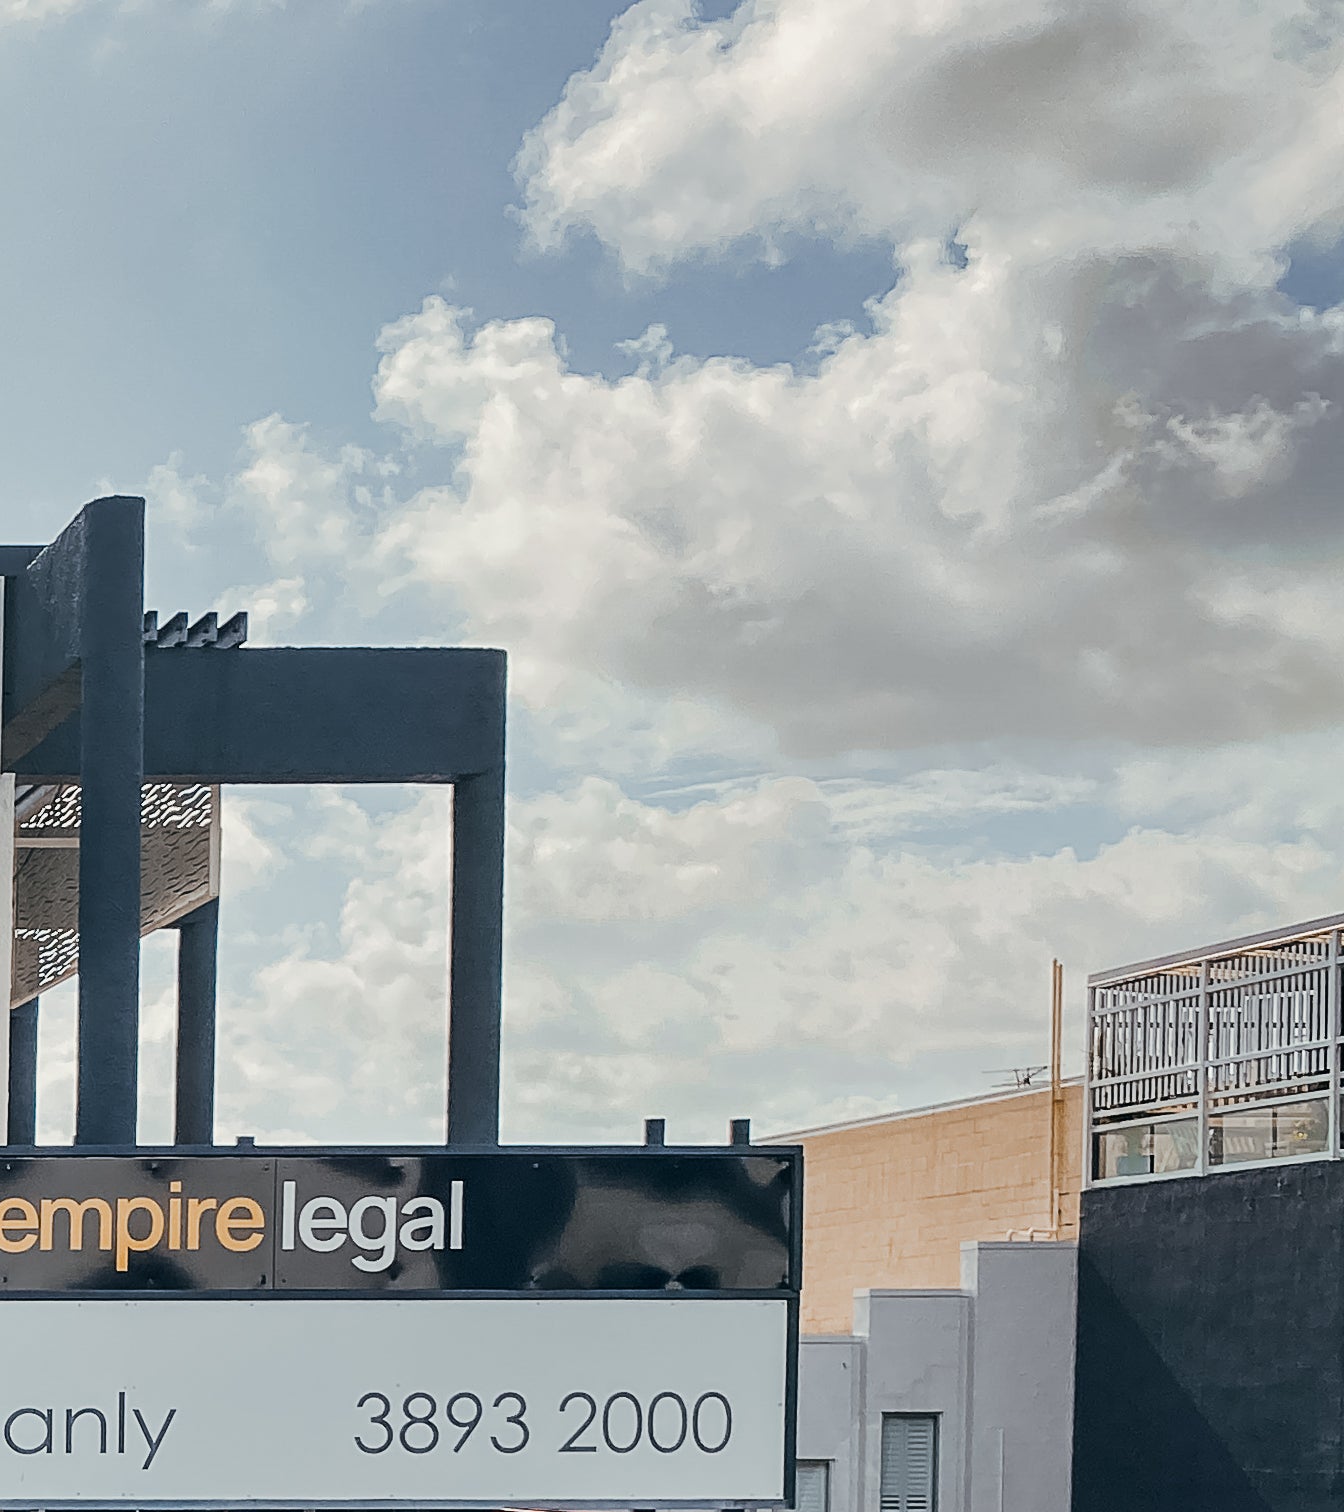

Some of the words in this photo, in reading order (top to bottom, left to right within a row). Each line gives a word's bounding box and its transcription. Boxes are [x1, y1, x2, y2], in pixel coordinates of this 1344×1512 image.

[281, 1180, 465, 1273] legal
[354, 1391, 530, 1455] 3893
[558, 1391, 733, 1455] 2000
